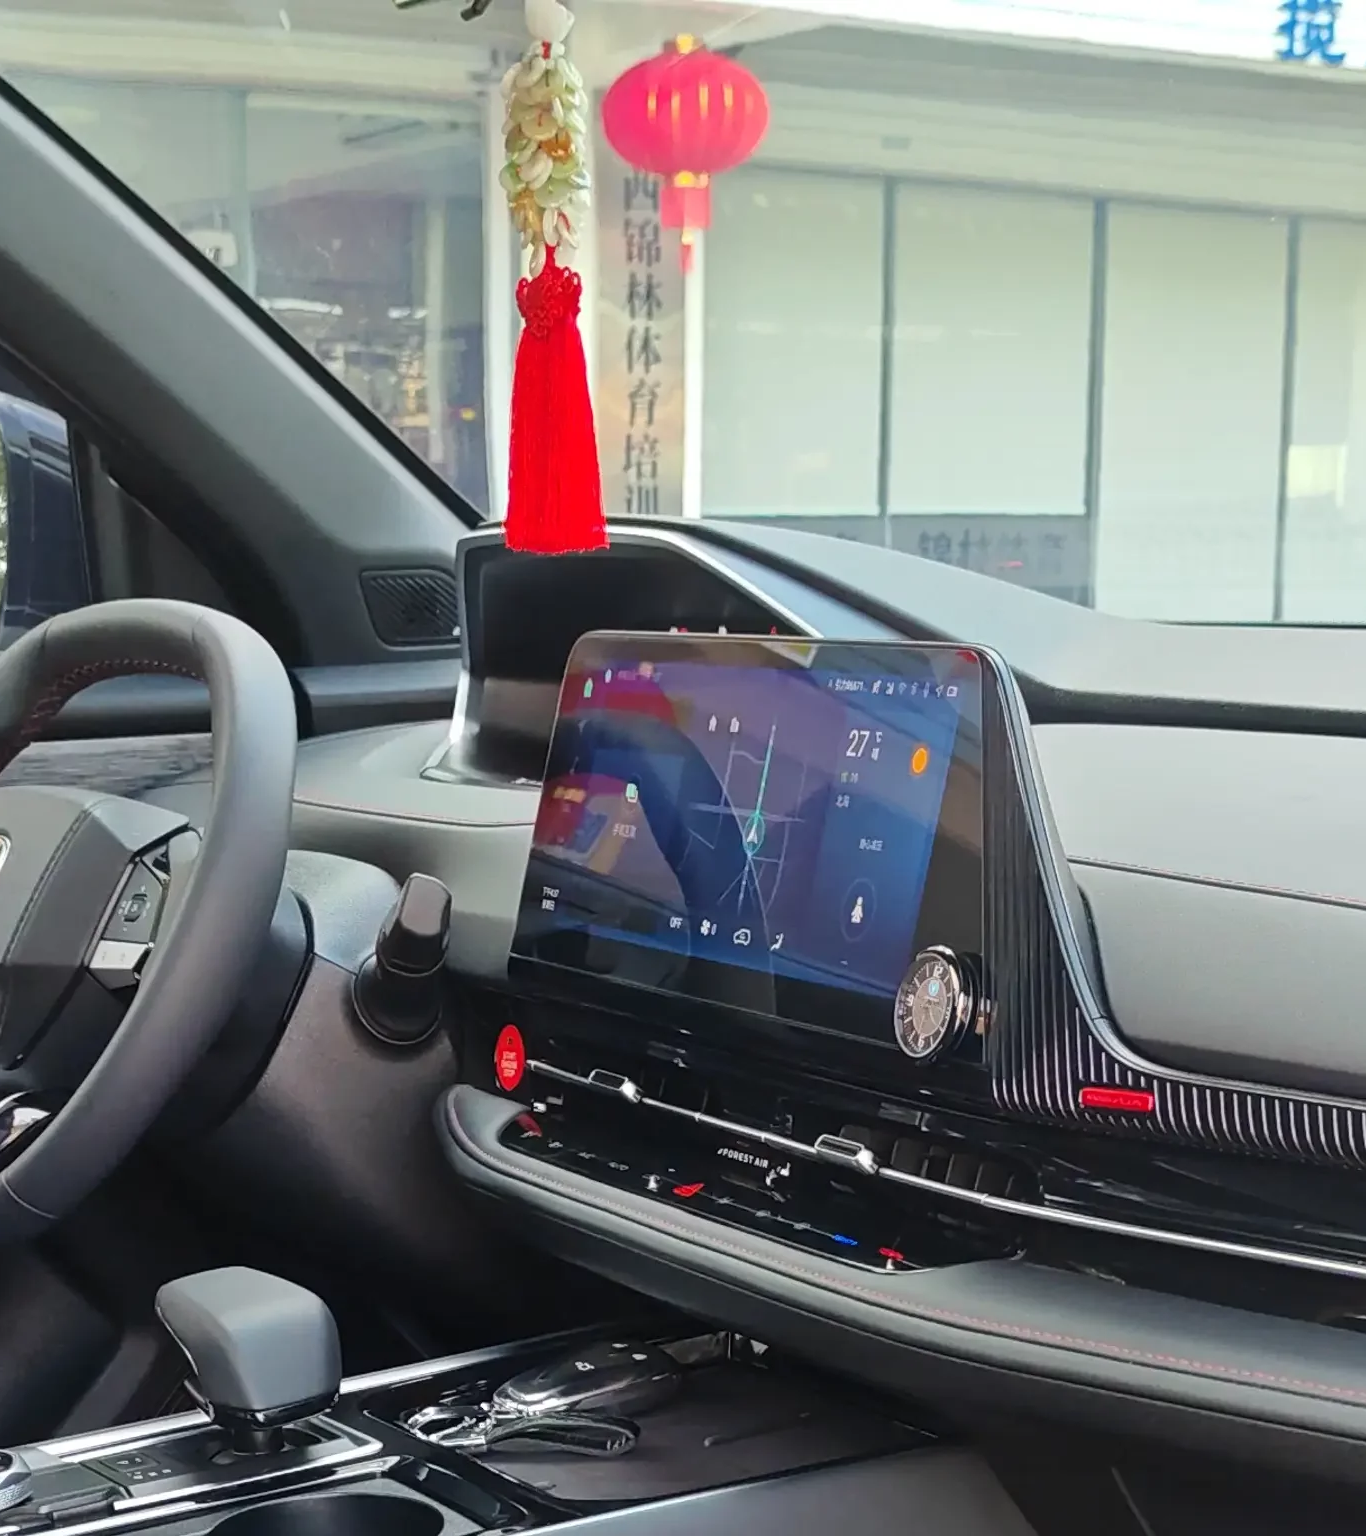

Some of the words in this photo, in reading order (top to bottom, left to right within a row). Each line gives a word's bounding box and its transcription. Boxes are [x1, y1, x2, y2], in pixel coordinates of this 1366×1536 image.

[846, 729, 870, 757] 27
[669, 916, 683, 930] OFF
[753, 1157, 769, 1168] AIR
